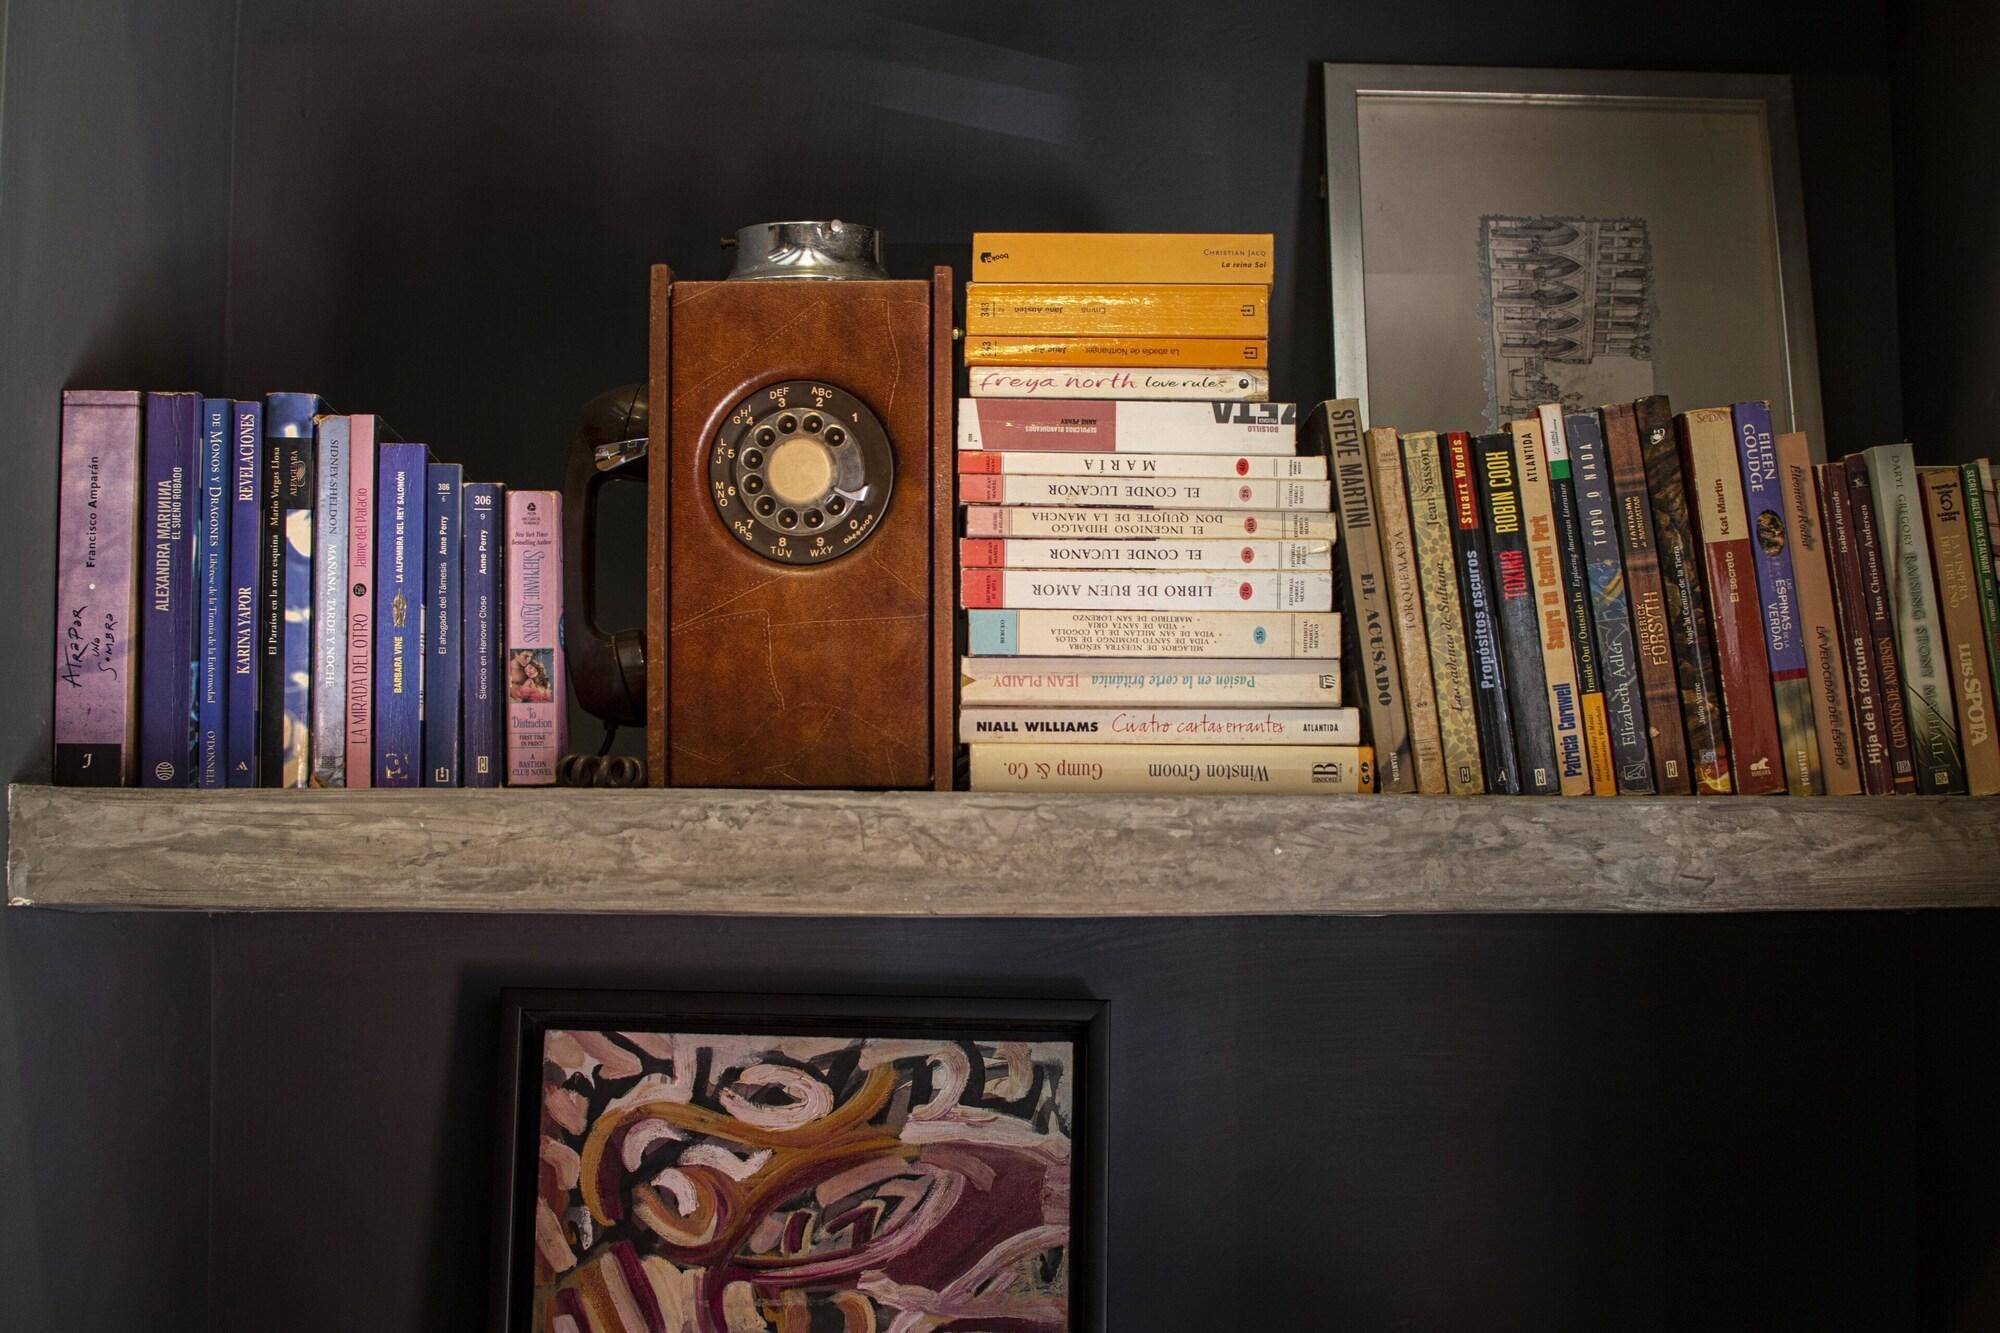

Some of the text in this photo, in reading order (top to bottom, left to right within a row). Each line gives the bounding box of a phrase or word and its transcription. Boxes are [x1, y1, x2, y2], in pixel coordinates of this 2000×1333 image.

[1203, 249, 1266, 258] CHRISTIAN JACQ
[769, 386, 790, 400] DEF
[778, 397, 786, 408] 3
[811, 386, 832, 399] ABC
[816, 397, 823, 407] 2
[733, 404, 752, 424] GHI
[746, 416, 753, 426] 4
[851, 412, 858, 423] 1
[238, 413, 255, 501] REVELACIONES
[727, 449, 735, 459] 5
[1084, 459, 1158, 474] MARÍA
[1578, 443, 1597, 480] NADA
[1742, 423, 1764, 493] GOUDGE
[1758, 431, 1777, 480] EILEEN
[289, 449, 299, 497] ALFAGUARA
[328, 439, 339, 535] SIDNEY SHELDON
[437, 482, 450, 491] 306
[728, 486, 736, 496] 6
[1048, 484, 1201, 499] EL CONDE LUCANOR
[1421, 449, 1441, 528] Jean Sasson
[1453, 439, 1472, 524] Stuart Woods
[86, 456, 99, 567] Francisco Amparán
[474, 495, 492, 505] 306
[715, 481, 728, 507] MNO
[1714, 478, 1730, 535] Kat Martin
[355, 487, 368, 568] Jaime del Palacio
[395, 471, 405, 583] LA ALFOMBRA DEL REY SALOMÓN
[439, 515, 449, 555] Anne Perry
[734, 521, 753, 541] PRS
[746, 519, 754, 529] 7
[849, 519, 858, 530] 0
[1032, 511, 1224, 524] DON QUIJOTE DE LA MANCHA
[1051, 523, 1205, 536] EL INGENIOSO HIDALGO
[1588, 509, 1607, 546] TODO
[1860, 504, 1873, 549] Andersen
[155, 480, 172, 612] ALEXANDRA MARININA
[268, 447, 282, 655] El Paraíso en la otra esquina Mario Vargas Llosa
[478, 529, 489, 575] Anne Perry
[770, 546, 793, 558] TUV
[778, 537, 787, 547] 8
[810, 545, 834, 558] WXY
[816, 537, 825, 546] 9
[1050, 548, 1203, 561] EL CONDE LUCANOR
[1032, 583, 1213, 597] LIBRO DE BUEN AMOR
[1393, 531, 1416, 632] TORQUEMADA
[1497, 550, 1528, 600] TOXINA
[1867, 550, 1880, 594] Christian
[1331, 409, 1400, 782] STEVE MARTINI EL ACUSADO ATLANTIDA
[1521, 432, 1583, 778] Patricia Cornwell Sangre en Central Park ATLANTIDA
[1874, 595, 1885, 620] Hans
[236, 587, 252, 675] KARINA YAPOR
[1466, 550, 1494, 689] Propósitos oscuros
[1636, 604, 1651, 656] FREDERICK
[1643, 592, 1669, 666] FORSYTH
[1767, 602, 1784, 651] VERDAD
[393, 636, 403, 694] BARBARA VINE
[478, 595, 488, 700] Silencio en Hanover Close
[1068, 643, 1204, 653] MILAGROS DE NUESTRA SEÑORA
[1878, 636, 1896, 687] ANDERSEN
[351, 613, 368, 744] LA MIRADA DEL OTRO
[993, 673, 1079, 689] JEAN PLAIDY
[1091, 674, 1256, 689] Pasión en la corte británica
[1609, 641, 1637, 747] Elizabeth Adler
[1884, 687, 1898, 700] DE
[1957, 643, 1989, 747] LUIS SPOTA
[1852, 637, 1883, 765] Hija de la fortuna
[976, 721, 1099, 733] NIALL WILLIAMS
[1111, 713, 1284, 734] Cuatro cartas errantes
[1302, 723, 1339, 732] ATLANTIDA
[1886, 702, 1905, 749] CUENTOS
[205, 730, 216, 786] O'DONNELL
[1003, 761, 1104, 781] Gump & Co.
[1148, 763, 1270, 782] Winston Groom
